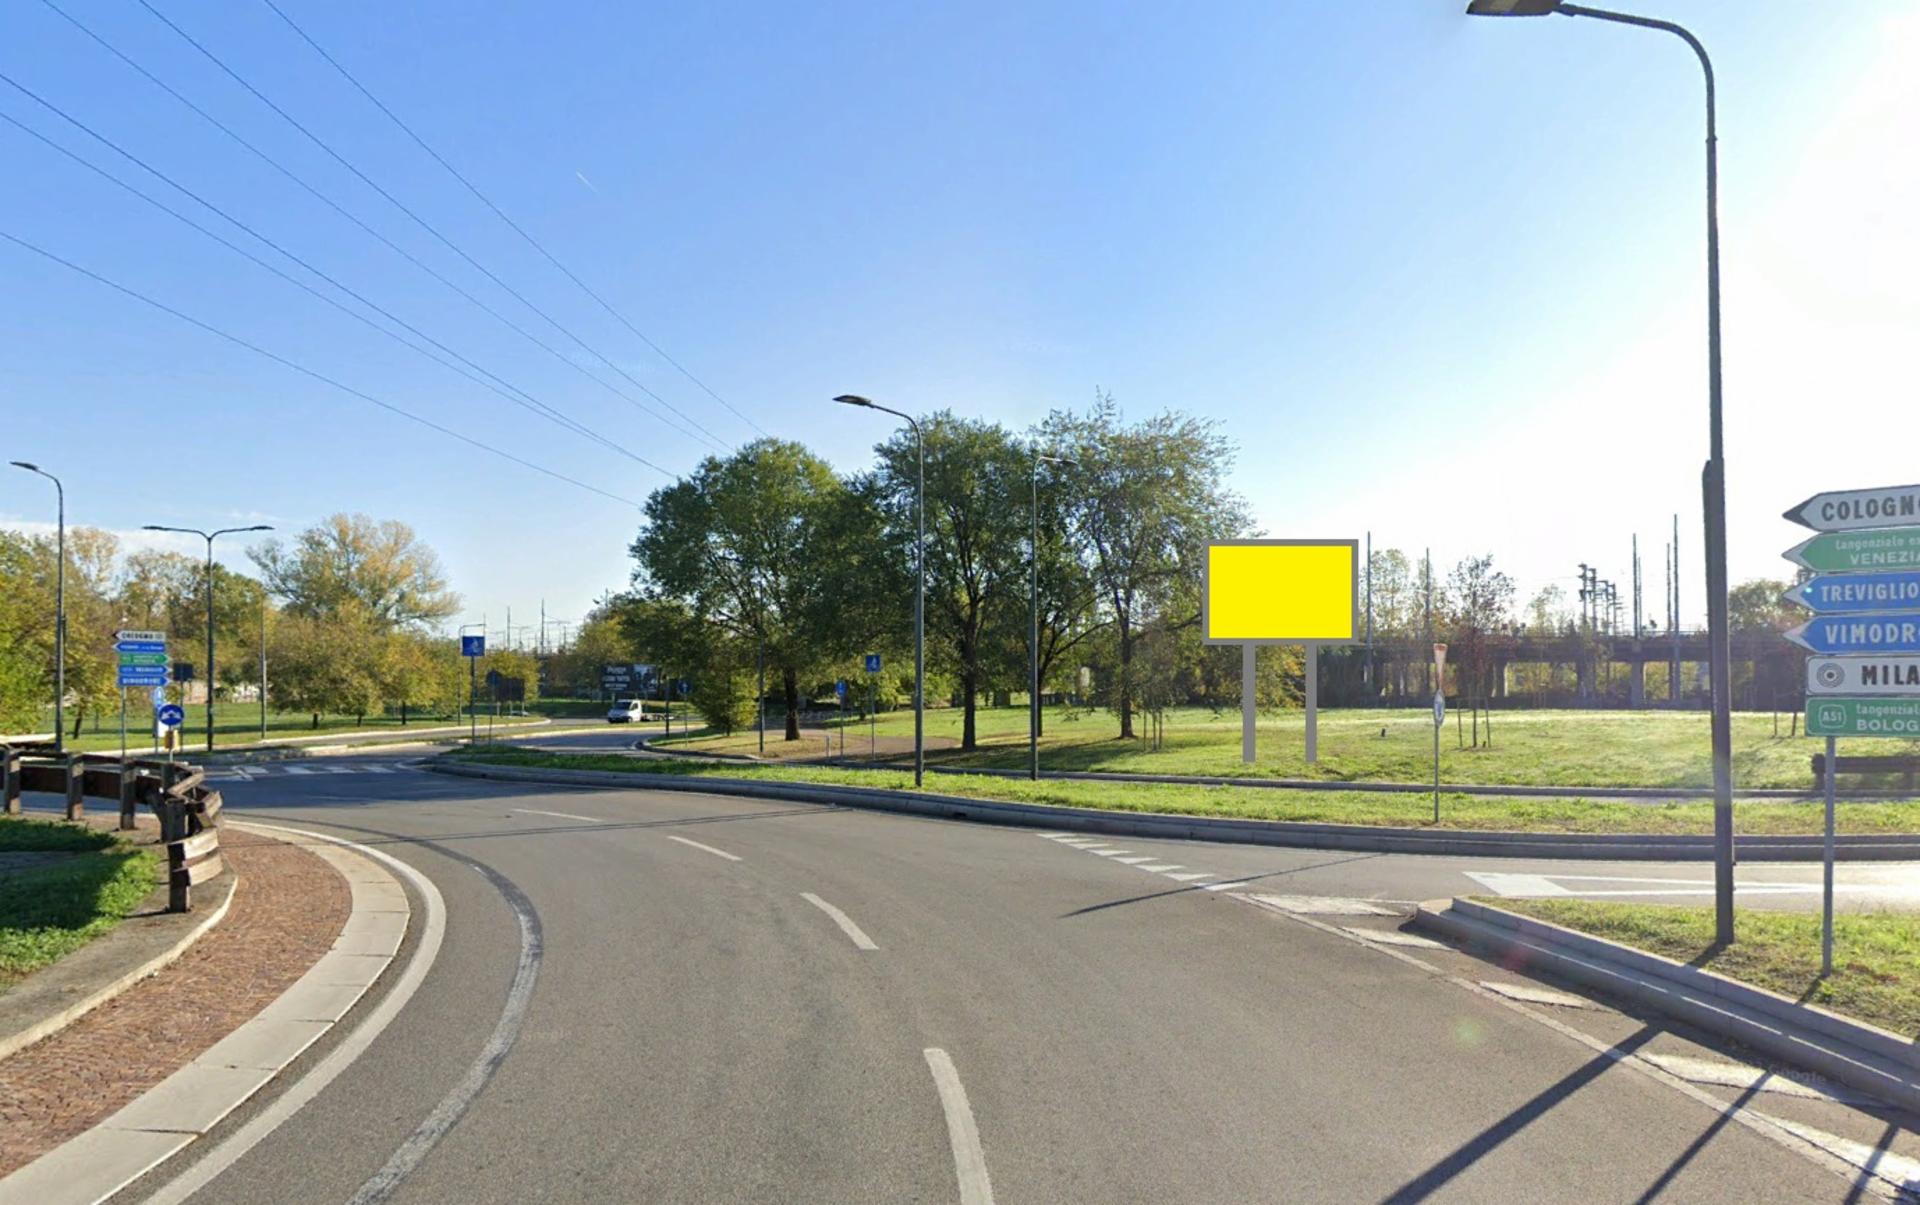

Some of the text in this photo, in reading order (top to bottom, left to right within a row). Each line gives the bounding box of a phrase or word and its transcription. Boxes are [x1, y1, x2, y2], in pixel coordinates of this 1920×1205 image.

[1821, 495, 1920, 522] COLOGN
[1821, 582, 1919, 603] TREVIGLIO
[1825, 622, 1920, 645] VIMODR
[1822, 711, 1843, 723] A51
